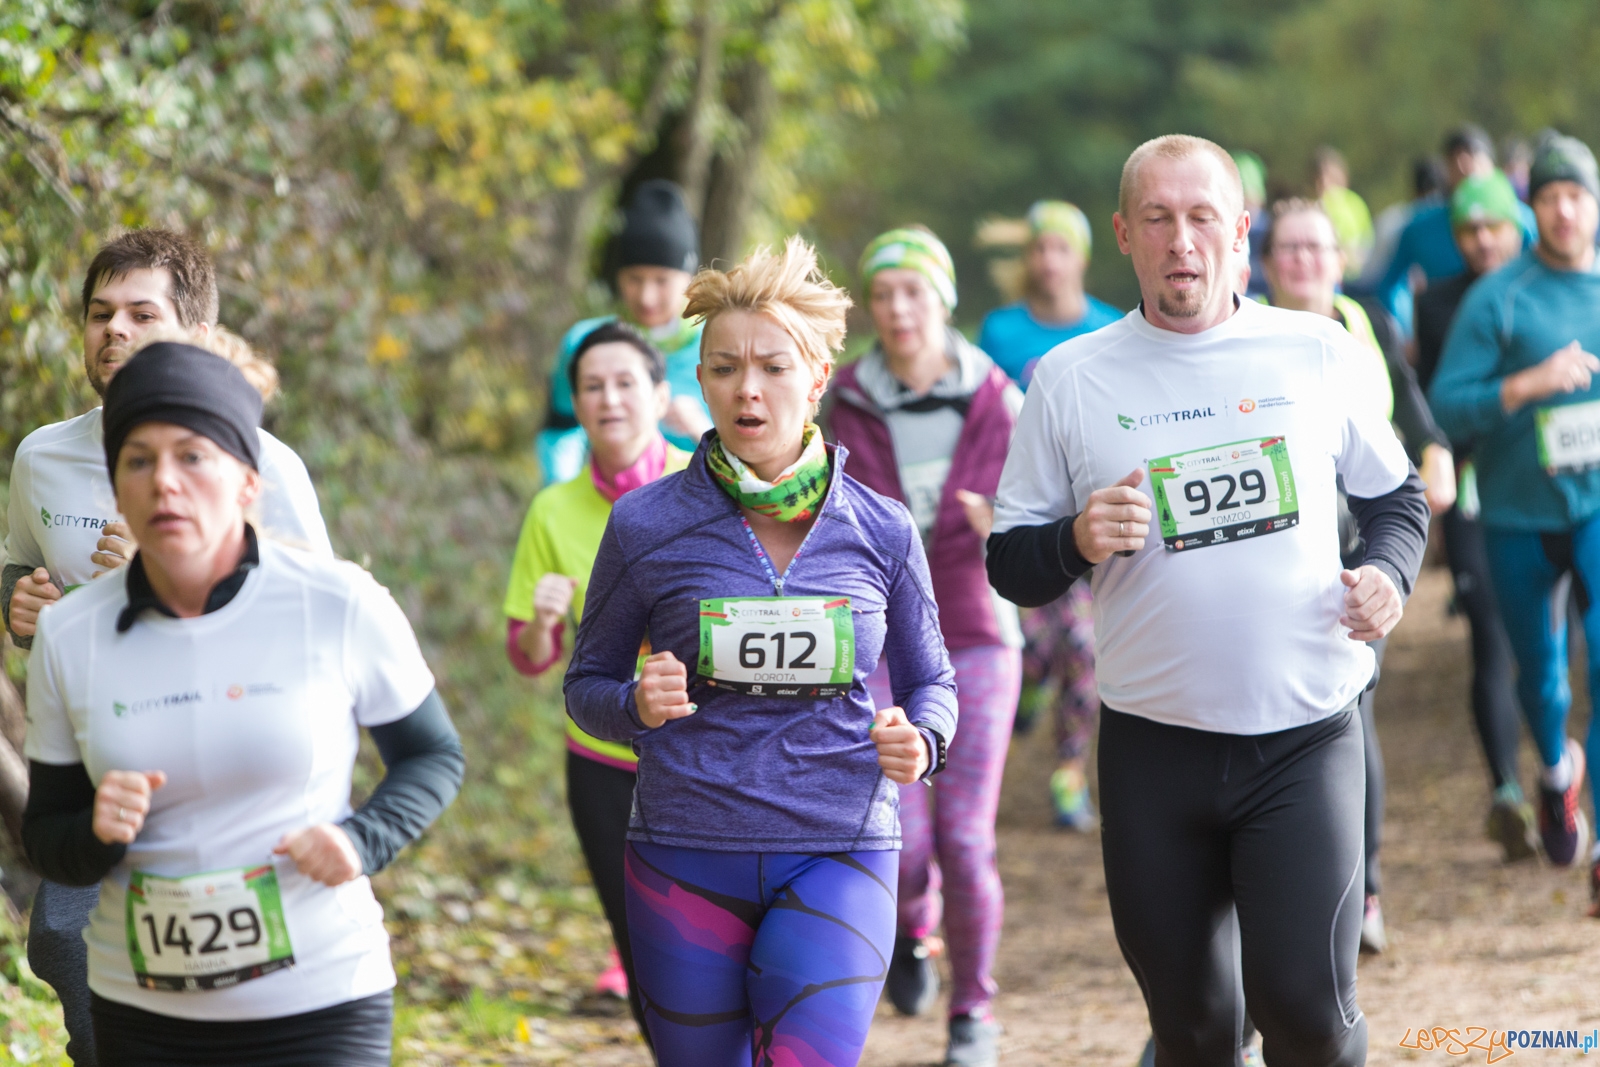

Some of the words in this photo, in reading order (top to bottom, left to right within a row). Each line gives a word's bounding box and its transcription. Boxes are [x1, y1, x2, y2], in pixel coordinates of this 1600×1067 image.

[1183, 468, 1267, 516] 929
[1210, 510, 1252, 526] TOMZOO
[739, 631, 817, 669] 612
[839, 639, 849, 674] Poznań
[754, 673, 797, 682] DOROTA
[142, 906, 262, 956] 1429
